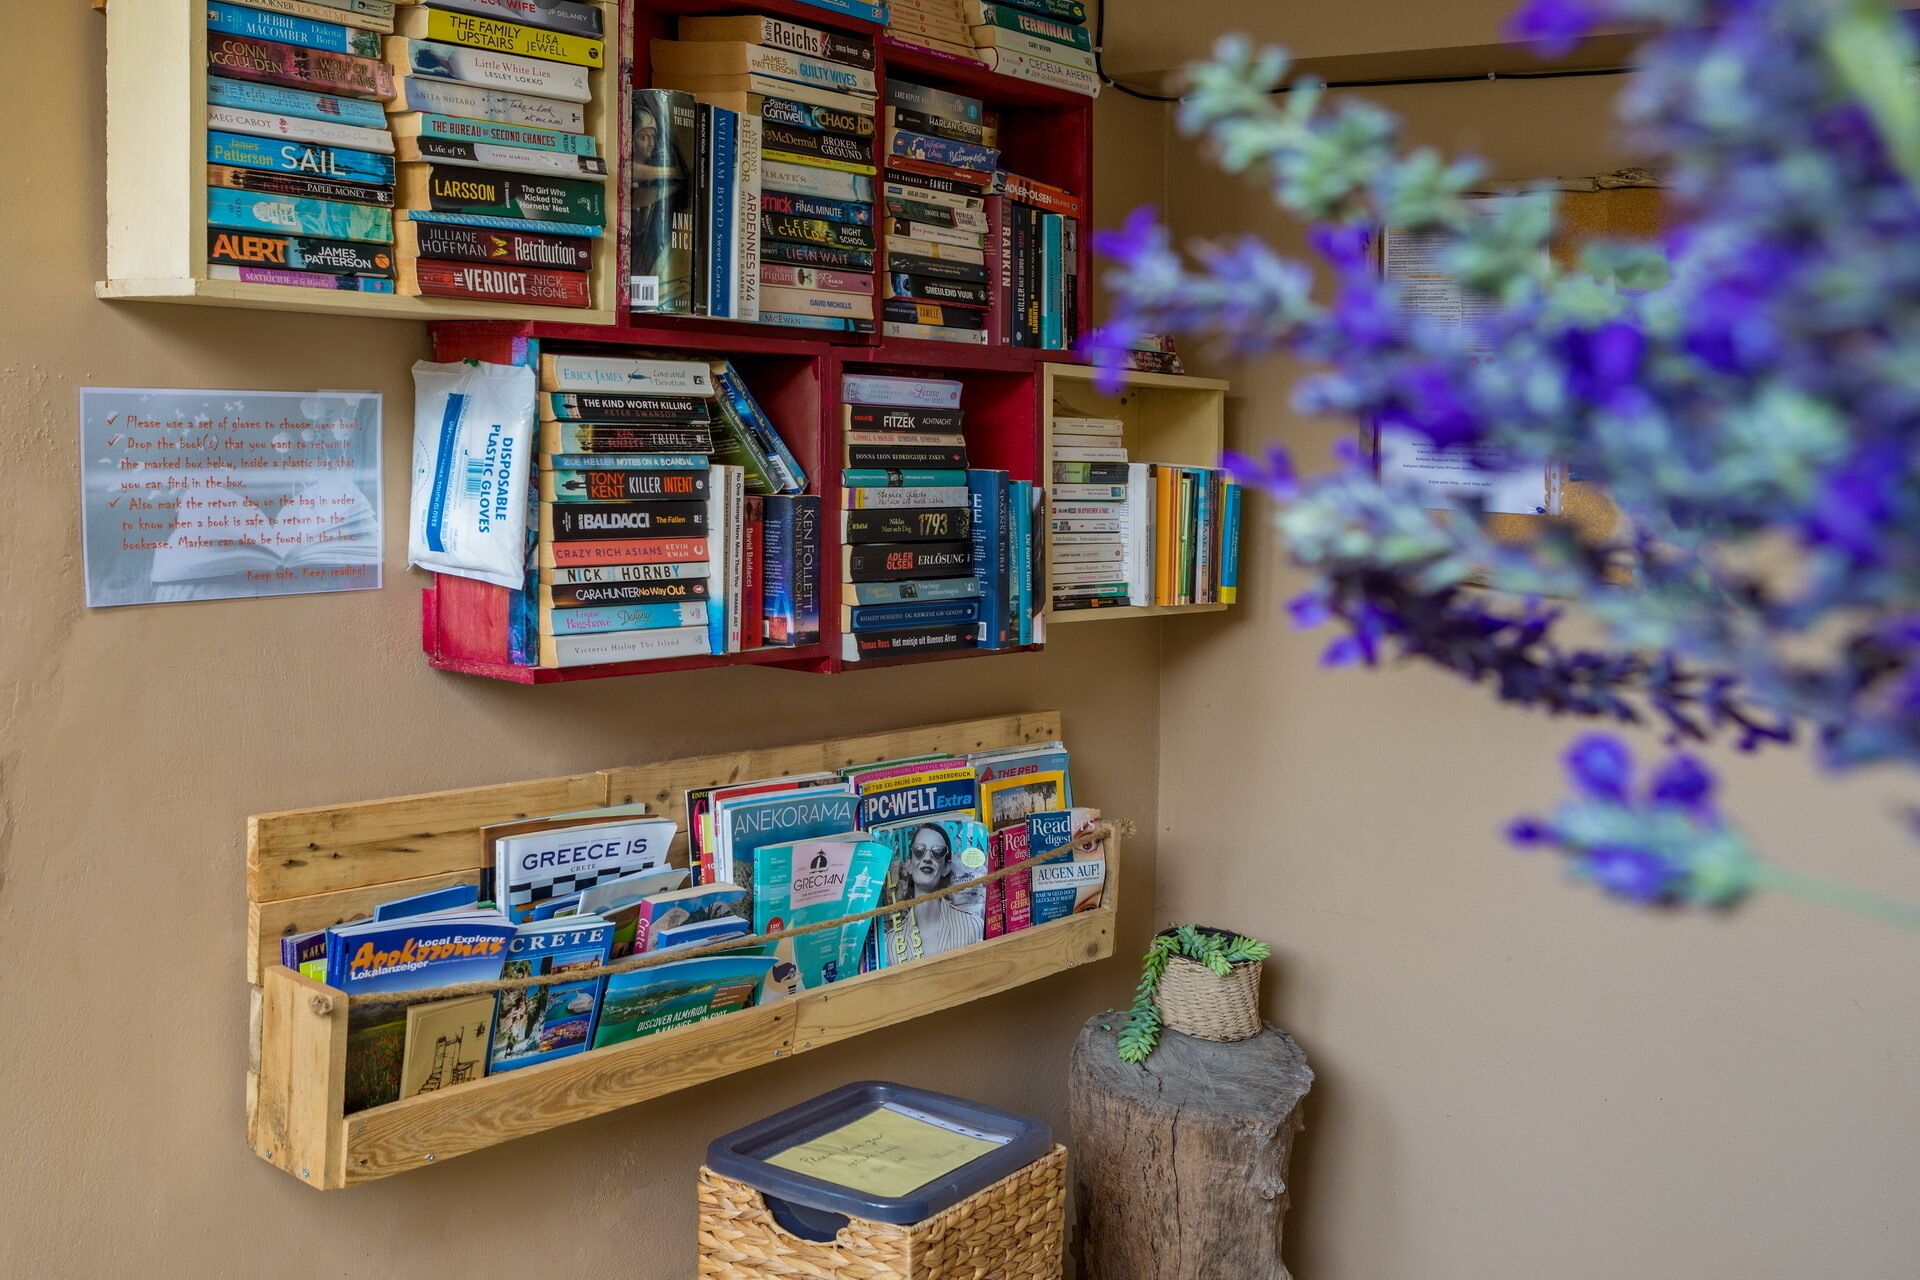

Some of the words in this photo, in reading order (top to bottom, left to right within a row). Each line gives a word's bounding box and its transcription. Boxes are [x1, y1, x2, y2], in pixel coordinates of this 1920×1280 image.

[507, 2, 536, 13] WIFE
[258, 13, 295, 29] DEBBIE
[450, 16, 474, 30] THE
[479, 19, 520, 39] FAMILY
[1018, 15, 1075, 42] TERMINAAL
[247, 23, 308, 43] MACOMBER
[457, 30, 514, 50] UPSTAIRS
[536, 33, 558, 45] LISA
[764, 20, 773, 42] Kathy
[774, 22, 818, 53] Reichs
[222, 40, 267, 60] CONN
[527, 41, 567, 57] JEWELL
[211, 51, 283, 74] IGGULDEN
[475, 58, 499, 70] Little
[502, 62, 530, 75] White
[533, 66, 550, 78] Lies
[752, 59, 797, 76] PATTERSON
[761, 53, 787, 66] JAMES
[800, 63, 828, 78] GUILTY
[831, 71, 857, 86] WIVES
[1029, 59, 1063, 75] CECELIA
[1066, 67, 1092, 82] AHERN
[763, 105, 804, 123] Cornwell
[770, 100, 797, 112] Patricia
[209, 113, 232, 123] MEG
[235, 117, 271, 128] CABOT
[819, 113, 854, 130] CHAOS
[929, 116, 957, 129] HARLAN
[958, 122, 981, 135] COBEN
[229, 138, 260, 151] James
[772, 131, 817, 149] McDermid
[822, 136, 856, 149] BROKEN
[214, 146, 274, 165] Patterson
[281, 146, 345, 176] SAIL
[821, 146, 862, 161] GROUND
[435, 180, 495, 201] LARSSON
[429, 229, 477, 243] JILLIANE
[747, 193, 755, 269] ARDENNES
[212, 234, 290, 263] ALERT
[318, 246, 356, 258] JAMES
[515, 237, 575, 265] Retribution
[1002, 227, 1011, 287] RANKIN
[305, 255, 371, 268] PATTERSON
[534, 275, 563, 287] NICK
[747, 274, 755, 302] 1944
[532, 286, 567, 298] STONE
[925, 286, 956, 297] SMEULEND
[957, 289, 973, 299] VUUR
[564, 369, 592, 381] ERICA
[596, 370, 623, 383] JAMES
[583, 399, 600, 407] THE
[602, 400, 624, 408] KIND
[626, 401, 659, 409] WORTH
[661, 401, 692, 410] KILLING
[127, 415, 160, 428] Please
[166, 420, 183, 428] use
[199, 420, 213, 429] set
[219, 416, 227, 429] of
[232, 418, 260, 432] gloves
[265, 420, 274, 429] to
[279, 418, 310, 430] choose
[315, 421, 334, 430] your
[128, 438, 152, 451] Drop
[158, 436, 176, 449] the
[180, 435, 219, 451] book(s)
[225, 438, 243, 449] that
[250, 441, 265, 453] you
[271, 440, 291, 449] want
[296, 440, 306, 449] to
[312, 440, 339, 449] return
[483, 424, 500, 476] PLASTIC
[121, 481, 140, 491] you
[145, 480, 162, 489] can
[168, 478, 187, 489] find
[191, 480, 200, 488] in
[206, 478, 221, 488] the
[227, 478, 246, 488] box.
[496, 438, 513, 521] DISPOSABLE
[590, 473, 625, 484] TONY
[629, 477, 661, 493] KILLER
[664, 477, 693, 492] INTENT
[592, 485, 624, 497] KENT
[129, 501, 152, 510] Also
[158, 500, 181, 509] mark
[187, 499, 202, 509] the
[208, 500, 237, 508] return
[243, 499, 259, 509] day
[279, 497, 294, 506] the
[299, 497, 315, 507] bag
[320, 497, 328, 505] in
[332, 497, 355, 505] order
[479, 481, 491, 533] GLOVES
[431, 503, 440, 527] GLOVES
[803, 509, 814, 539] KEN
[919, 513, 948, 536] 1793
[556, 549, 592, 559] CRAZY
[596, 548, 621, 557] RICH
[625, 547, 662, 556] ASIANS
[887, 552, 913, 561] ADLER
[247, 570, 271, 581] Keep
[276, 569, 297, 580] safe.
[302, 568, 327, 578] Keep
[331, 566, 366, 577] reading!
[568, 569, 602, 582] NICK
[622, 565, 679, 579] HORNBY
[887, 561, 913, 569] OLSEN
[803, 545, 814, 612] FOLLETT
[892, 638, 900, 647] Het
[902, 638, 918, 647] meisje
[927, 636, 943, 644] Buenos
[945, 634, 956, 642] Aires
[929, 771, 971, 781] SONDERDRUCK
[997, 767, 1017, 778] THE
[1018, 765, 1038, 774] RED
[937, 794, 972, 808] Extra
[734, 802, 850, 835] ANEKORAMA
[1045, 835, 1072, 846] digest
[523, 842, 620, 870] GREECE
[626, 839, 647, 855] IS
[571, 864, 596, 872] CRETE
[1038, 867, 1074, 881] AUGEN
[1078, 864, 1099, 876] AUF!
[794, 873, 844, 891] GREC14N
[418, 937, 450, 947] Local
[454, 935, 505, 943] Explorer
[509, 929, 604, 952] CRETE
[637, 918, 649, 948] Crete
[351, 938, 504, 969] Apokoronas
[351, 960, 428, 980] Lokalanzeiger
[637, 1013, 672, 1032] DISCOVER
[672, 1006, 707, 1021] ALMYRIDA
